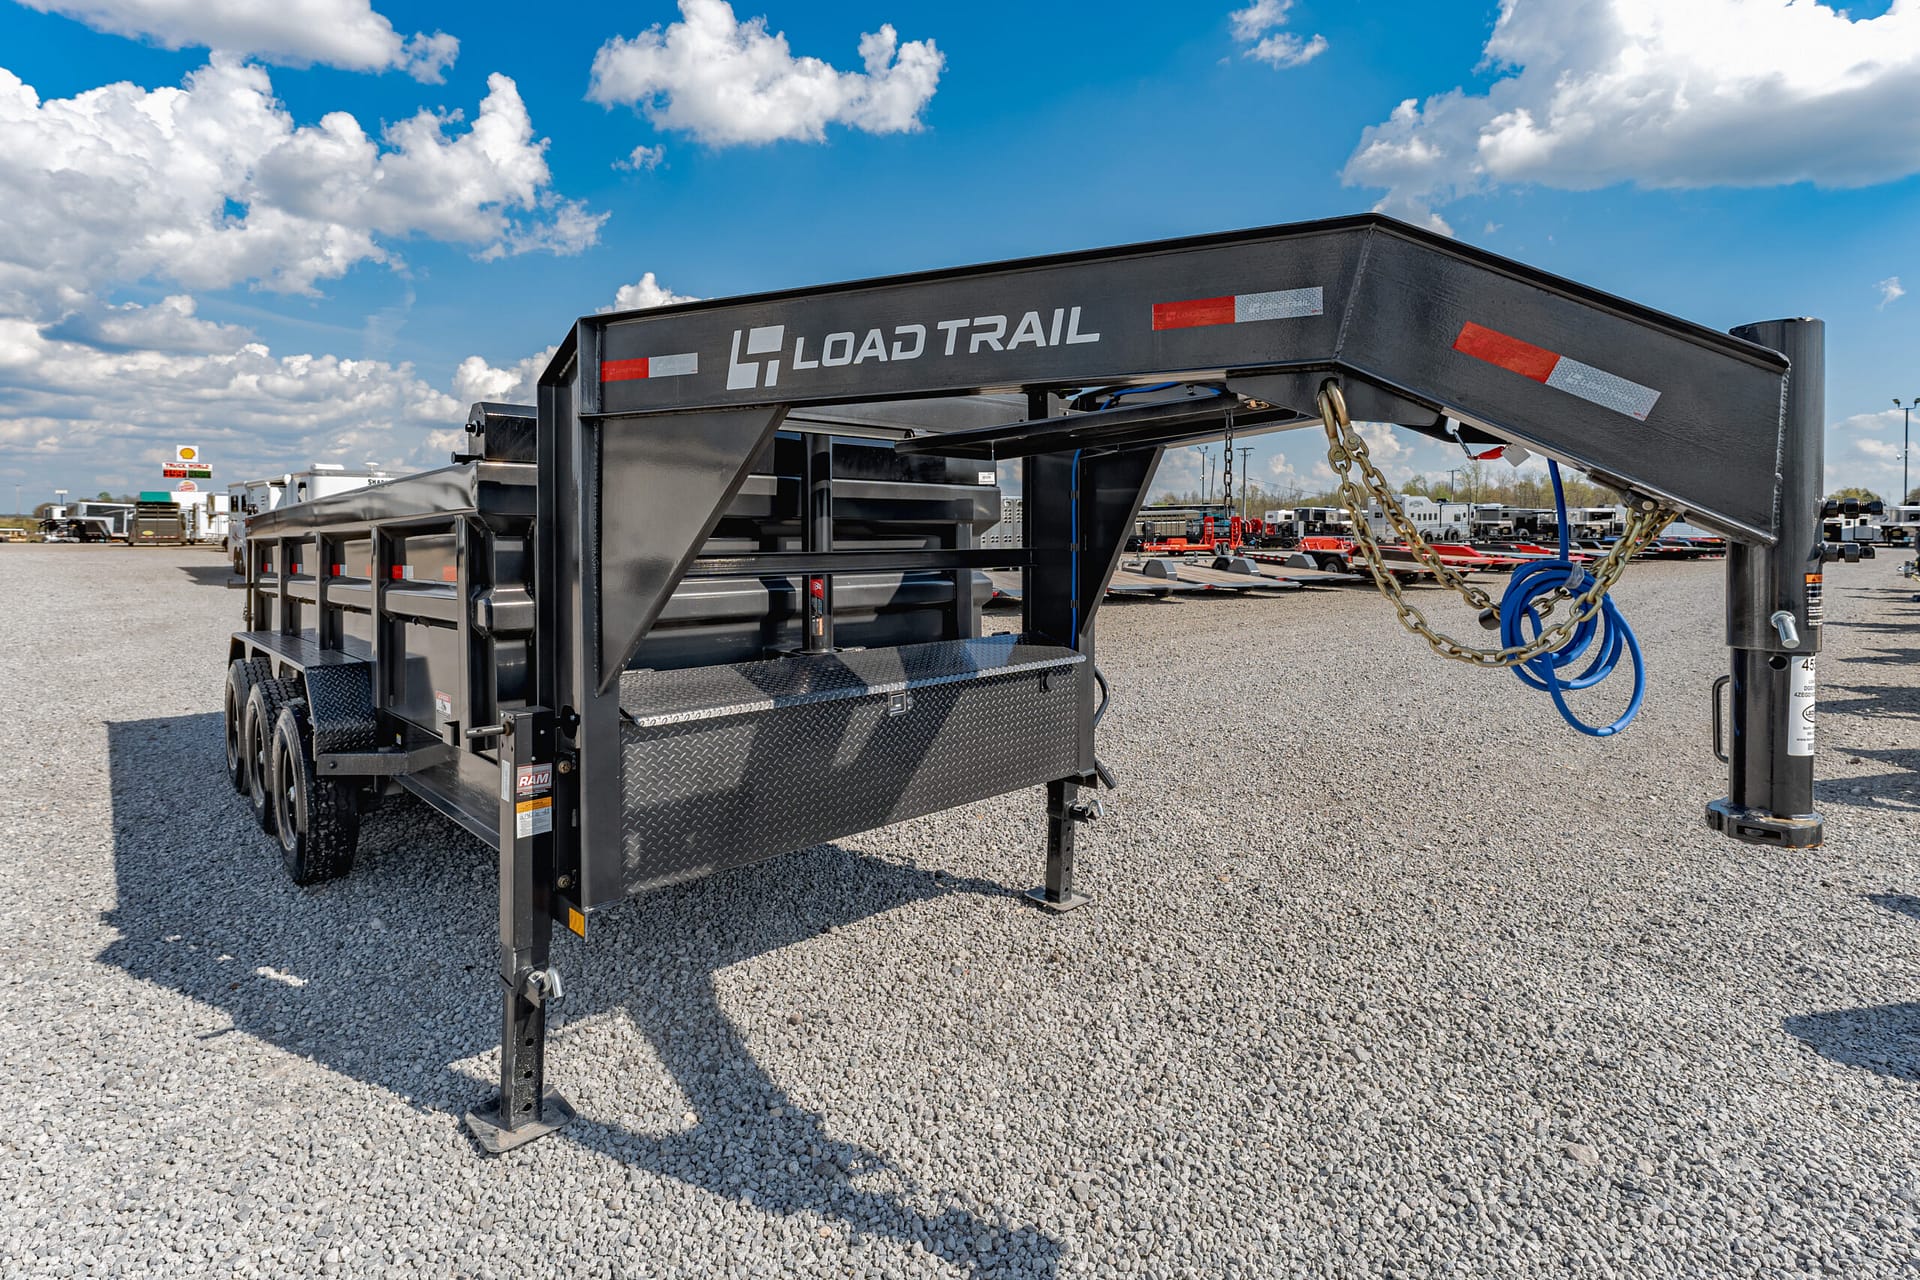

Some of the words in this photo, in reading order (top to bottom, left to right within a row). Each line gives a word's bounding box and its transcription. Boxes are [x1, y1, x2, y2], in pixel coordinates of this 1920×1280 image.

[792, 324, 927, 370] LOAD
[937, 306, 1101, 356] TRAIL
[519, 772, 550, 787] RAM
